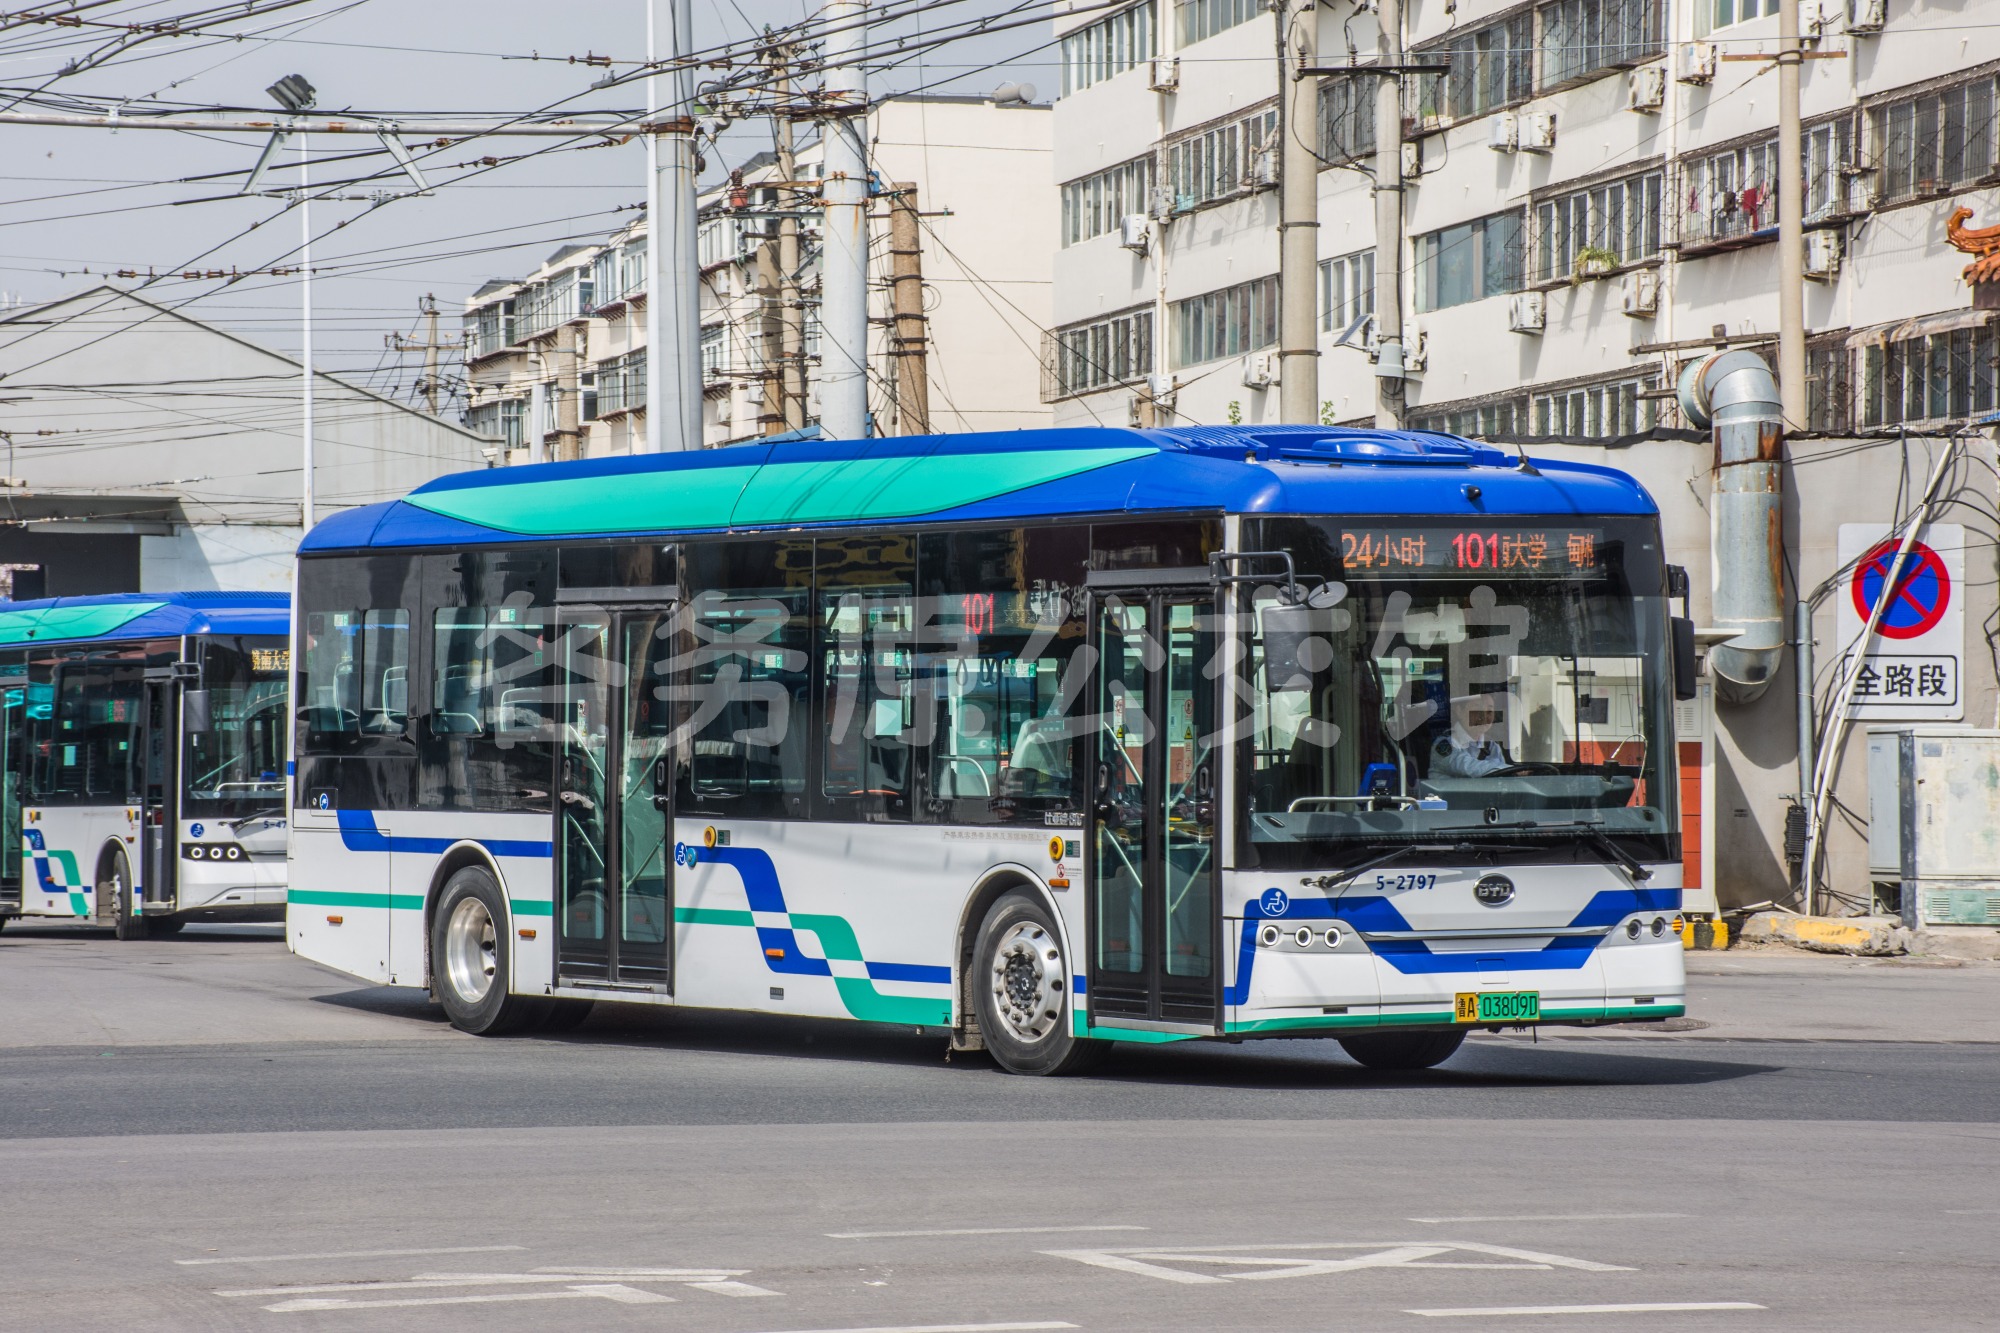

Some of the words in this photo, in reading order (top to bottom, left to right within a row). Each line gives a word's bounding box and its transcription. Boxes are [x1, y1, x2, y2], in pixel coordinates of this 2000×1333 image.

[1341, 533, 1427, 568] 24小时
[1452, 533, 1498, 568] 101
[961, 593, 995, 635] 101
[1853, 663, 1948, 697] 全路段
[1375, 874, 1437, 891] 5-2797
[1478, 883, 1511, 897] BYD
